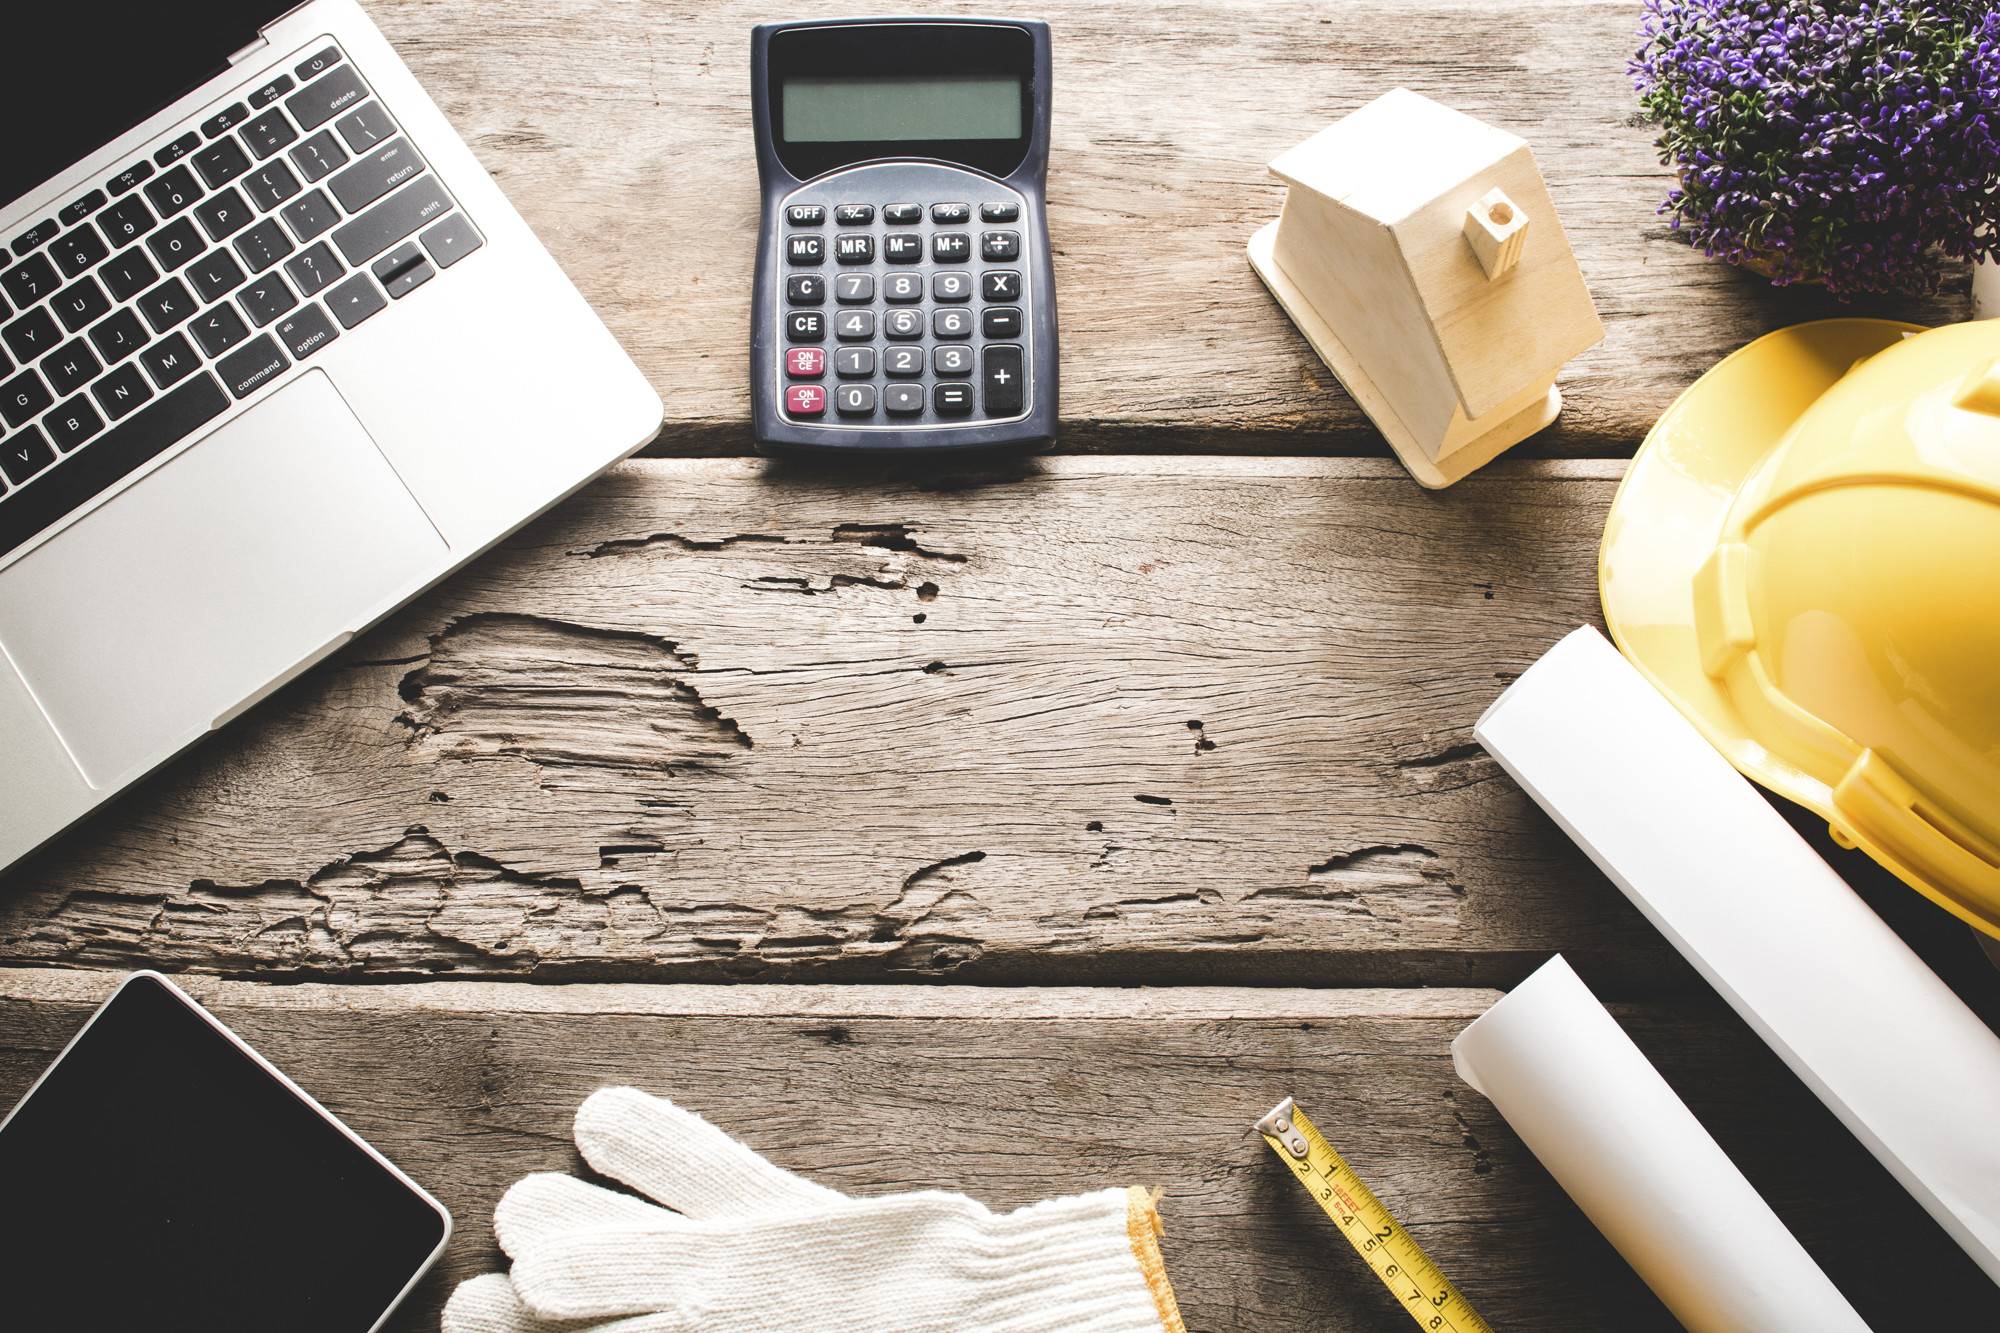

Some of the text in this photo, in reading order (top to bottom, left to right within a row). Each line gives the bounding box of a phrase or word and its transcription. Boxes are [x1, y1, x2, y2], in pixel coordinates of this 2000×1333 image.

[330, 89, 356, 109] delete
[380, 148, 398, 162] enter
[386, 165, 413, 185] return
[420, 201, 441, 217] shift
[794, 207, 819, 219] OFF
[216, 210, 227, 222] P
[124, 223, 134, 234] 9
[793, 240, 818, 254] MC
[842, 240, 866, 253] MR
[938, 238, 963, 251] M+
[76, 253, 86, 264] 8
[304, 256, 313, 268] ?
[209, 273, 221, 283] L
[28, 283, 36, 294] 7
[801, 279, 812, 294] C
[848, 279, 861, 294] 7
[896, 279, 910, 294] 8
[945, 278, 959, 293] 9
[73, 299, 85, 311] U
[161, 300, 174, 314] K
[284, 322, 294, 332] alt
[796, 317, 818, 332] CE
[846, 316, 862, 331] 4
[896, 315, 911, 331] 5
[945, 314, 960, 330] 6
[25, 330, 35, 341] Y
[117, 331, 124, 344] J
[297, 330, 325, 352] option
[162, 354, 177, 369] M
[799, 352, 814, 361] ON
[850, 353, 858, 369] 1
[897, 352, 911, 368] 2
[946, 351, 960, 367] 3
[64, 361, 77, 375] H
[799, 361, 813, 371] CE
[237, 360, 281, 391] command
[994, 368, 1011, 384] +
[115, 385, 128, 399] N
[799, 390, 814, 399] ON
[849, 390, 862, 406] 0
[945, 391, 962, 402] =
[17, 393, 28, 405] G
[803, 399, 811, 409] C
[67, 418, 79, 430] B
[17, 449, 28, 461] V
[1298, 1163, 1310, 1175] 2
[1324, 1164, 1338, 1178] 1
[1321, 1188, 1332, 1200] 3
[1342, 1216, 1354, 1226] 4
[1375, 1226, 1392, 1243] 2
[1363, 1239, 1376, 1251] 5
[1386, 1265, 1398, 1278] 6
[1408, 1289, 1421, 1301] 7
[1433, 1291, 1448, 1306] 3
[1429, 1316, 1442, 1329] 8
